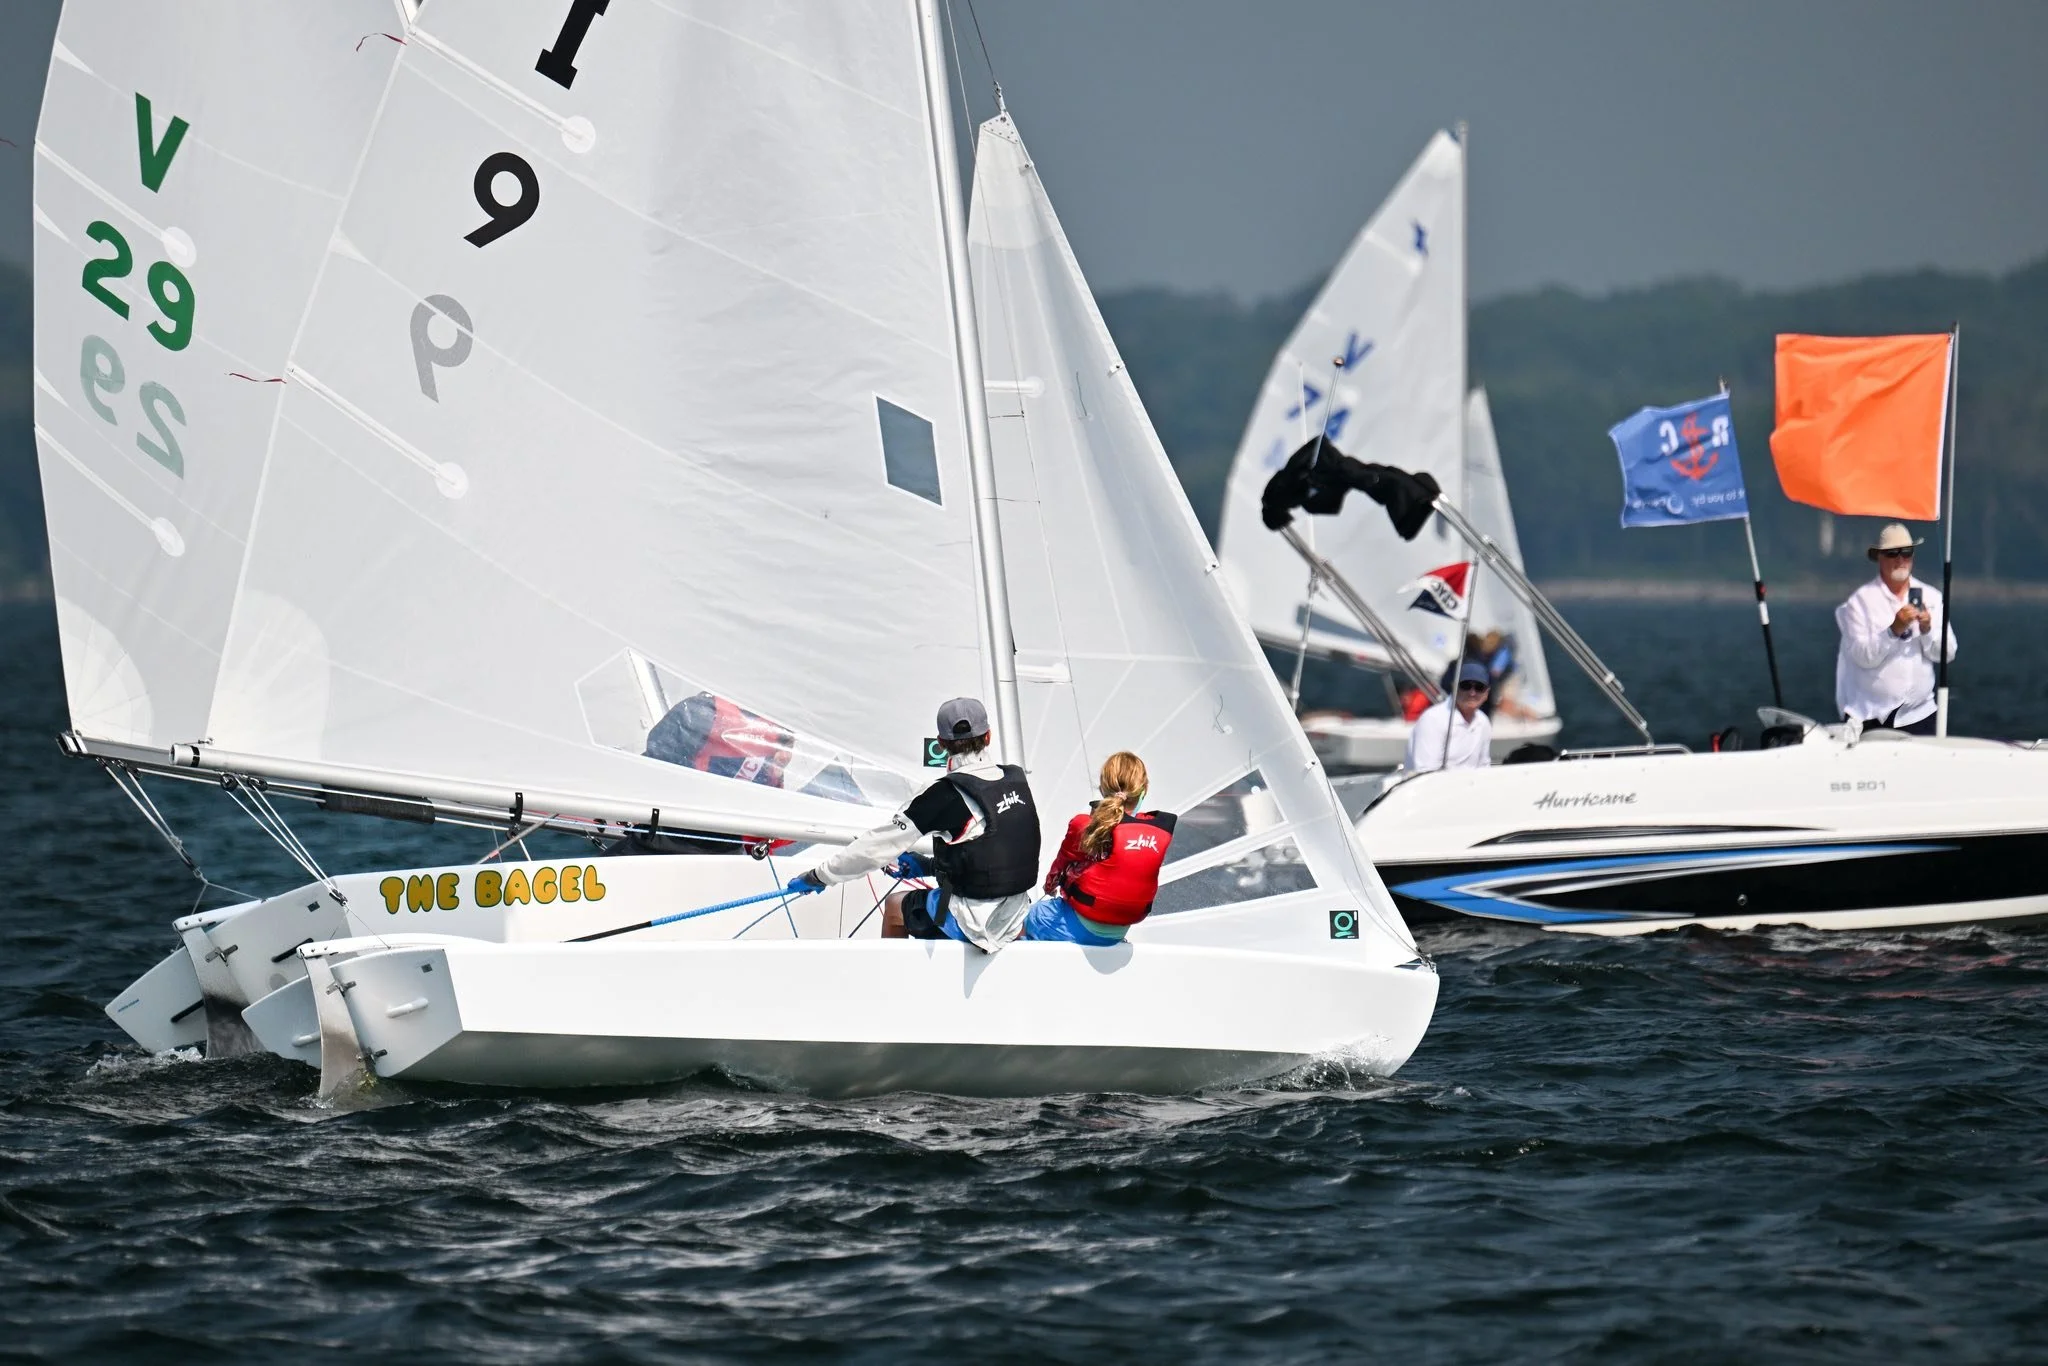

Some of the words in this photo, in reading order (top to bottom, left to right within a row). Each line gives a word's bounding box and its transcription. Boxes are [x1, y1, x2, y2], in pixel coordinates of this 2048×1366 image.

[135, 92, 190, 194] V
[463, 152, 540, 248] 9
[81, 220, 195, 351] 29
[1532, 790, 1639, 810] Hurricane
[1856, 780, 1886, 791] 201
[379, 873, 460, 915] THE
[474, 865, 606, 909] BAGEL
